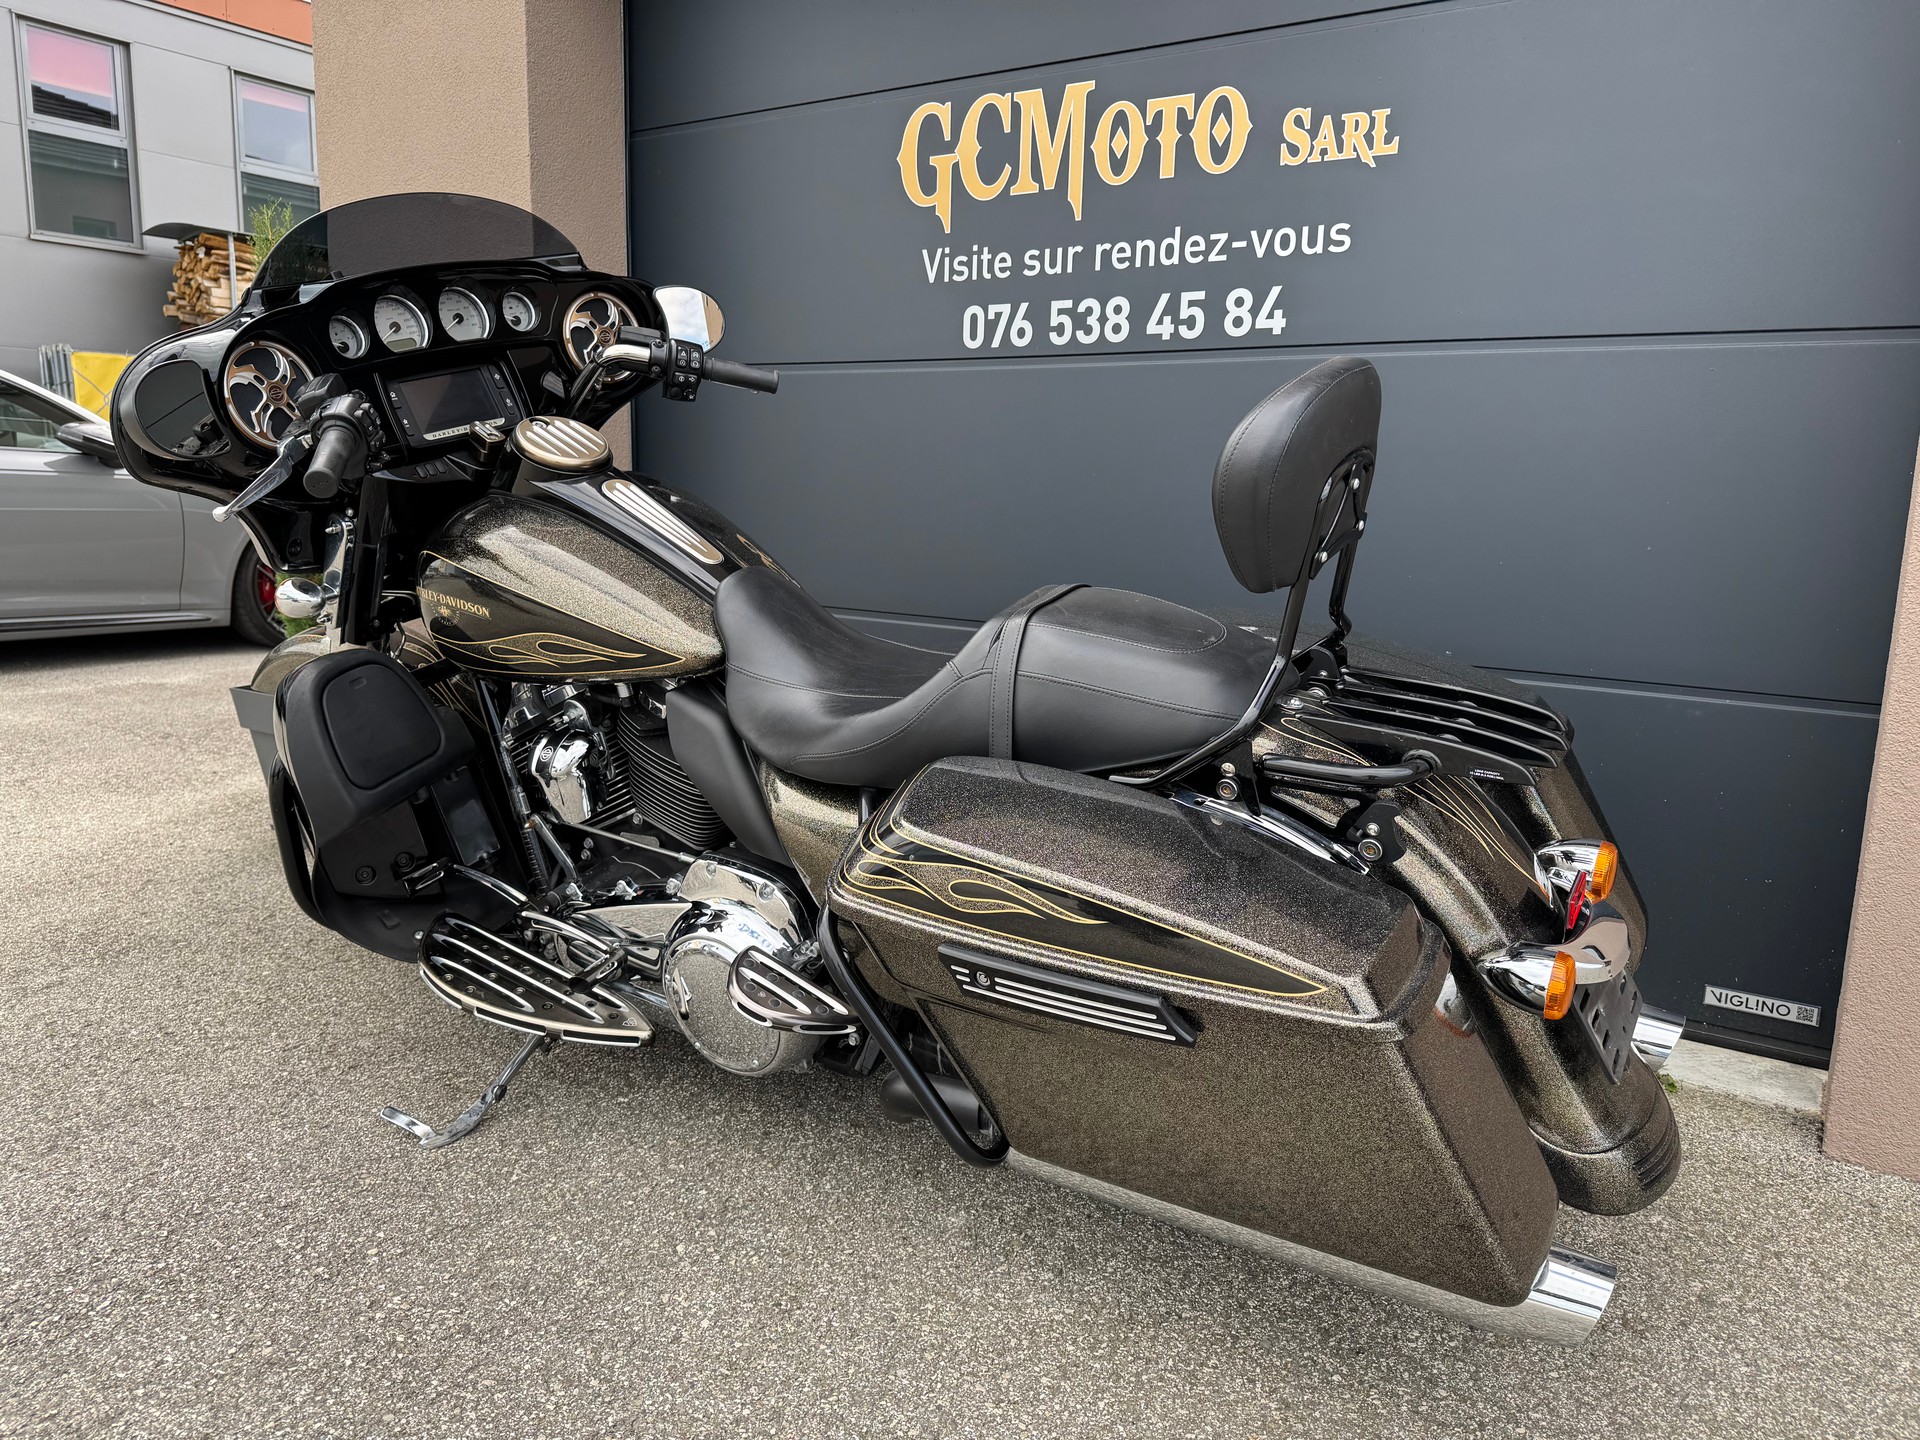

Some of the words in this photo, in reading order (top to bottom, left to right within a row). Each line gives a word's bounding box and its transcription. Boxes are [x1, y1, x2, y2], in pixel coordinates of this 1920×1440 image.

[922, 245, 1012, 284] Visite
[1022, 243, 1083, 276] sur
[1094, 221, 1352, 272] rendez-vous
[962, 302, 1034, 349] 076
[1048, 296, 1131, 346] 538
[1146, 290, 1206, 341] 45
[1223, 285, 1287, 338] 84
